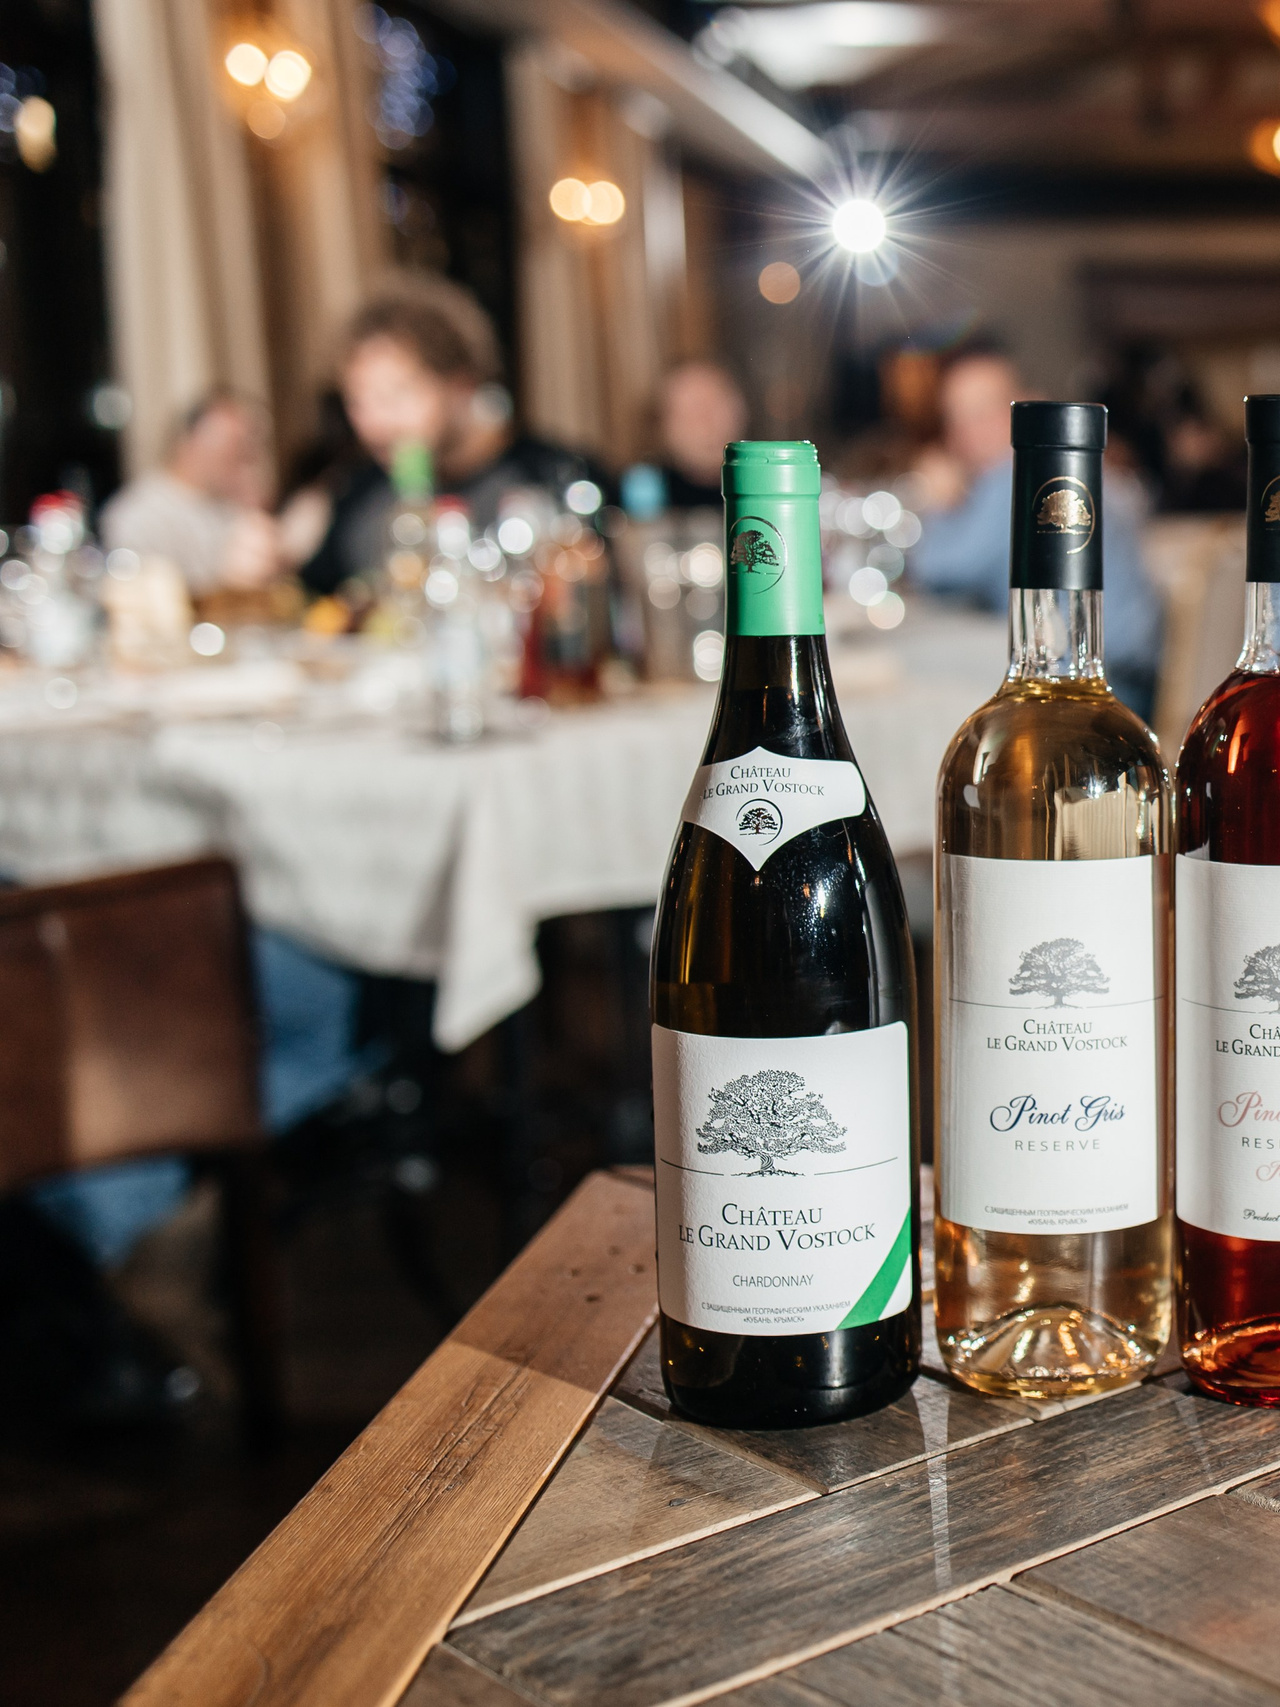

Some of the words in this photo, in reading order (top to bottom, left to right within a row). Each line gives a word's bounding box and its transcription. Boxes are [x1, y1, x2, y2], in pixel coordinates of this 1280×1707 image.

[730, 765, 791, 780] CHÂTEAU
[703, 787, 714, 799] LE
[715, 782, 758, 797] GRAND
[762, 779, 825, 797] VOSTOCK
[1022, 1018, 1093, 1035] CHÂTEAU
[987, 1037, 1001, 1050] LE
[1004, 1035, 1058, 1052] GRAND
[1061, 1035, 1128, 1052] VOSTOCK
[1215, 1040, 1229, 1053] LE
[989, 1094, 1072, 1132] Pinot
[1074, 1095, 1126, 1132] Gris
[1014, 1138, 1101, 1152] RESERVE
[721, 1203, 823, 1226] CHÂTEAU
[1243, 1208, 1280, 1223] Product
[679, 1224, 694, 1244] LE
[698, 1225, 771, 1251] GRAND
[776, 1223, 876, 1250] VOSTOCK
[732, 1274, 814, 1288] CHARDONNAY
[706, 1303, 751, 1314] ЗАЩИЩЕННЫМ
[752, 1305, 811, 1315] ГЕОГРАФИЧЕСКИМ
[812, 1300, 850, 1312] УКАЗАНИЕМ
